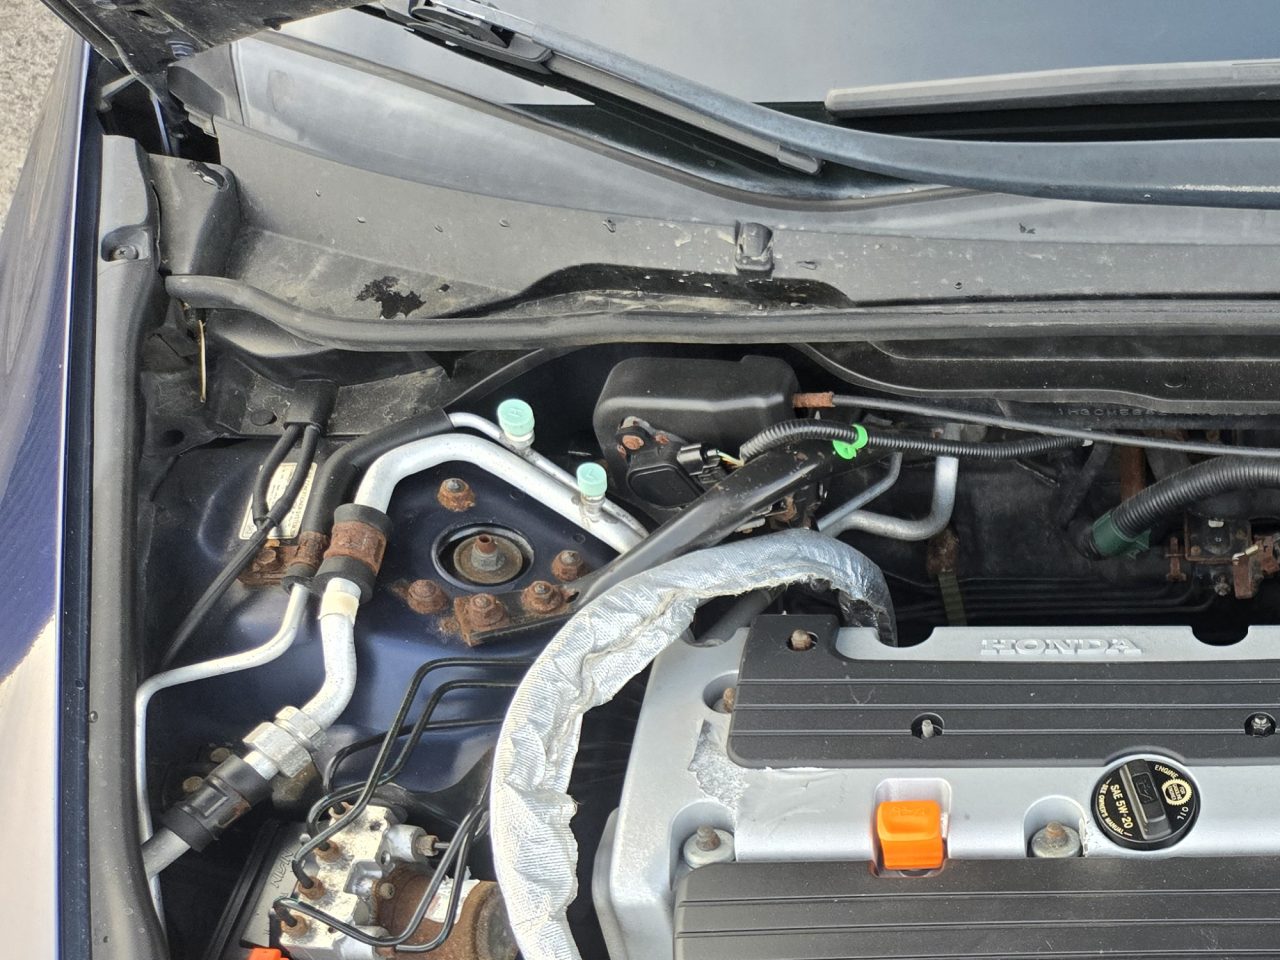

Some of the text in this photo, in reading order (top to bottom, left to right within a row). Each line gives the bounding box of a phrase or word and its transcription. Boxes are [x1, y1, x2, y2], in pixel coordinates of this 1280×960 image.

[980, 639, 1142, 655] HONDA
[1110, 784, 1123, 800] SAE
[1154, 764, 1189, 820] ENGINE OIL
[1104, 817, 1124, 835] MANUAL
